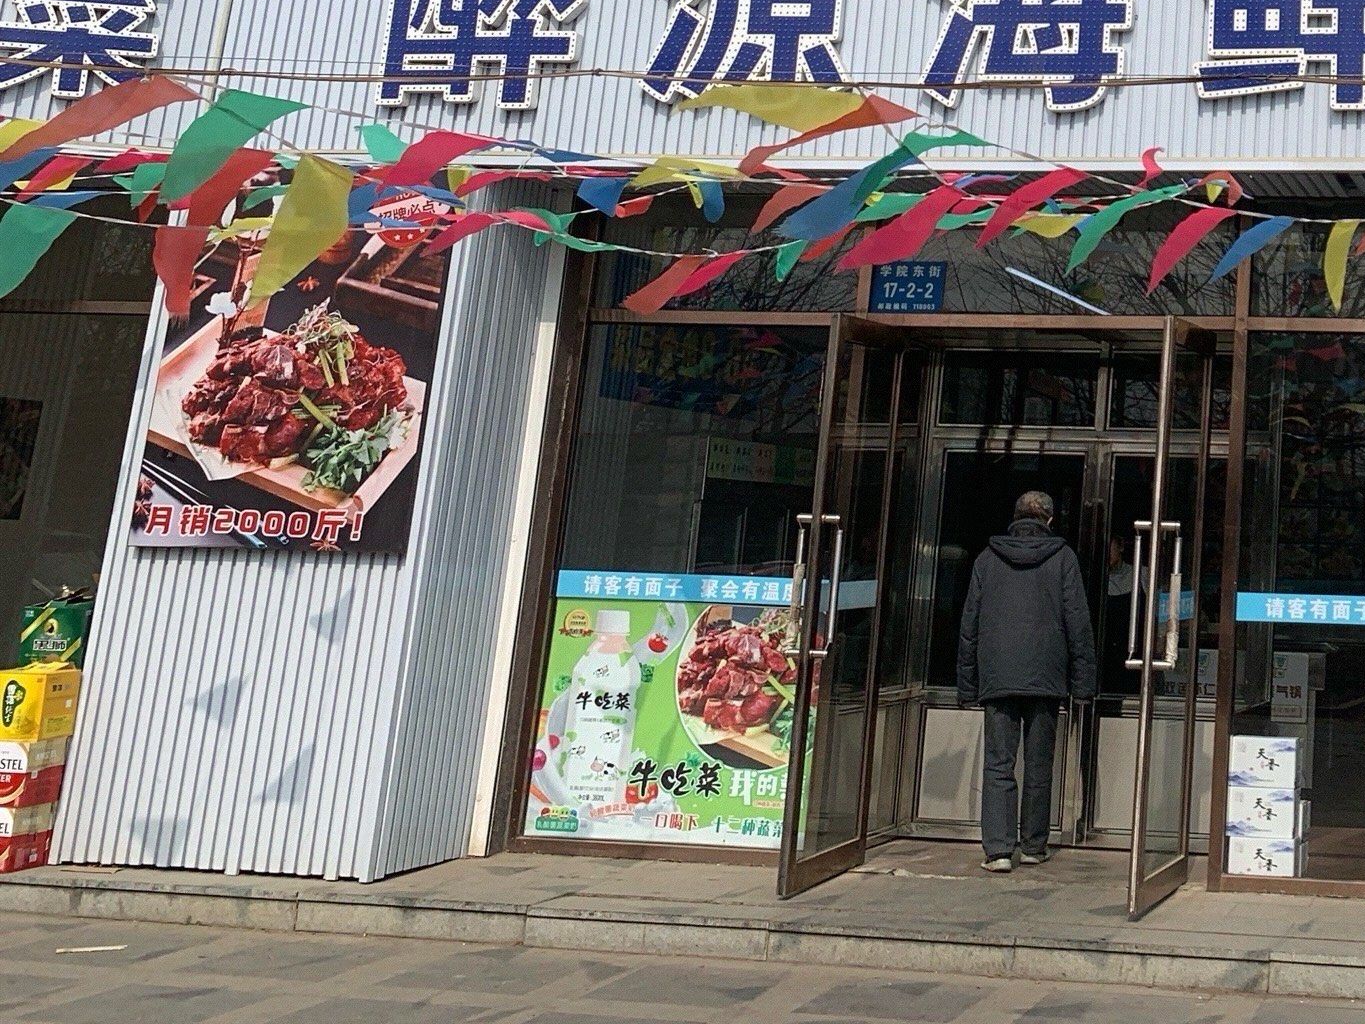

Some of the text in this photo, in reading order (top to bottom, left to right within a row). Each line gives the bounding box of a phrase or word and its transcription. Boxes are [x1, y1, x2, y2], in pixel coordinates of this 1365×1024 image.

[880, 265, 941, 278] 学院东街
[883, 282, 934, 299] 17-2-2
[584, 574, 683, 597] 请客有面子
[575, 691, 632, 711] 牛吃菜
[629, 759, 723, 799] 牛吃菜
[641, 813, 699, 832] 一口喝下
